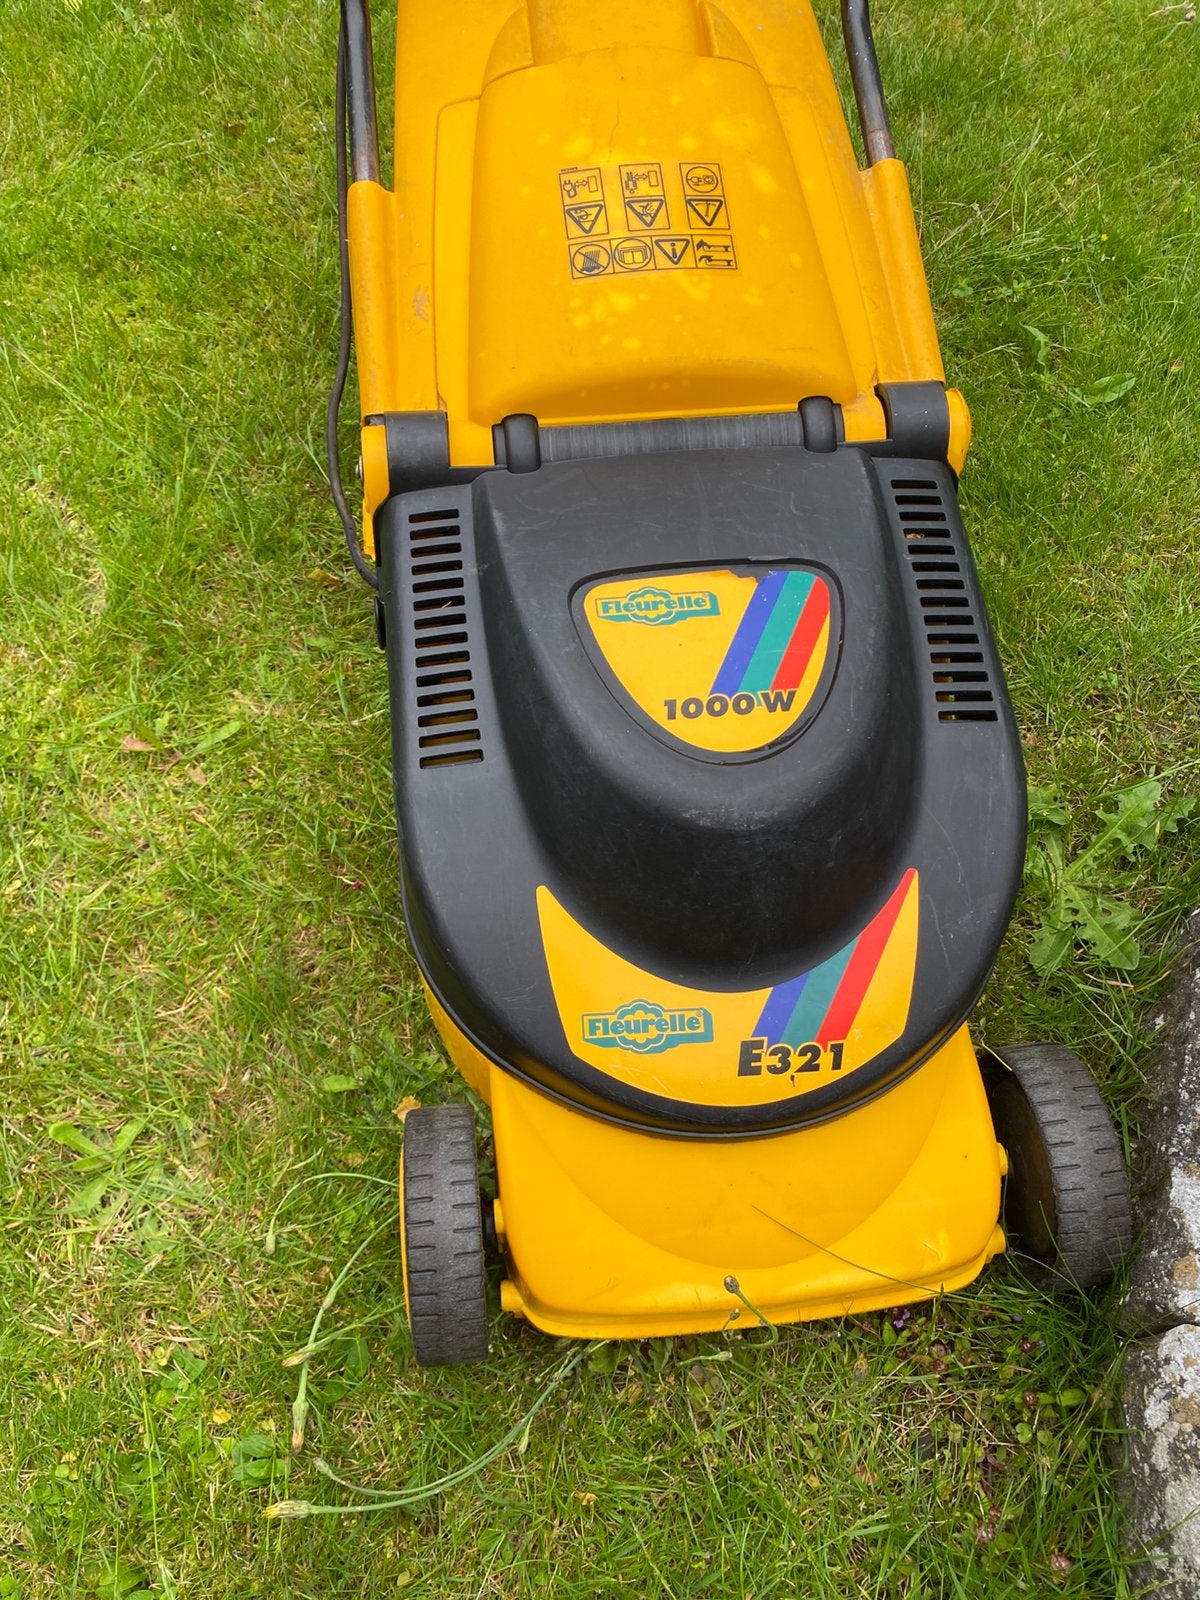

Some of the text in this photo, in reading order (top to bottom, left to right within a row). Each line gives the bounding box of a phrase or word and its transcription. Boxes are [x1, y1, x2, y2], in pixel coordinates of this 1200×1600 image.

[601, 595, 708, 614] Fleurelle
[588, 1013, 701, 1037] Fleurelle
[737, 1039, 844, 1076] E321
